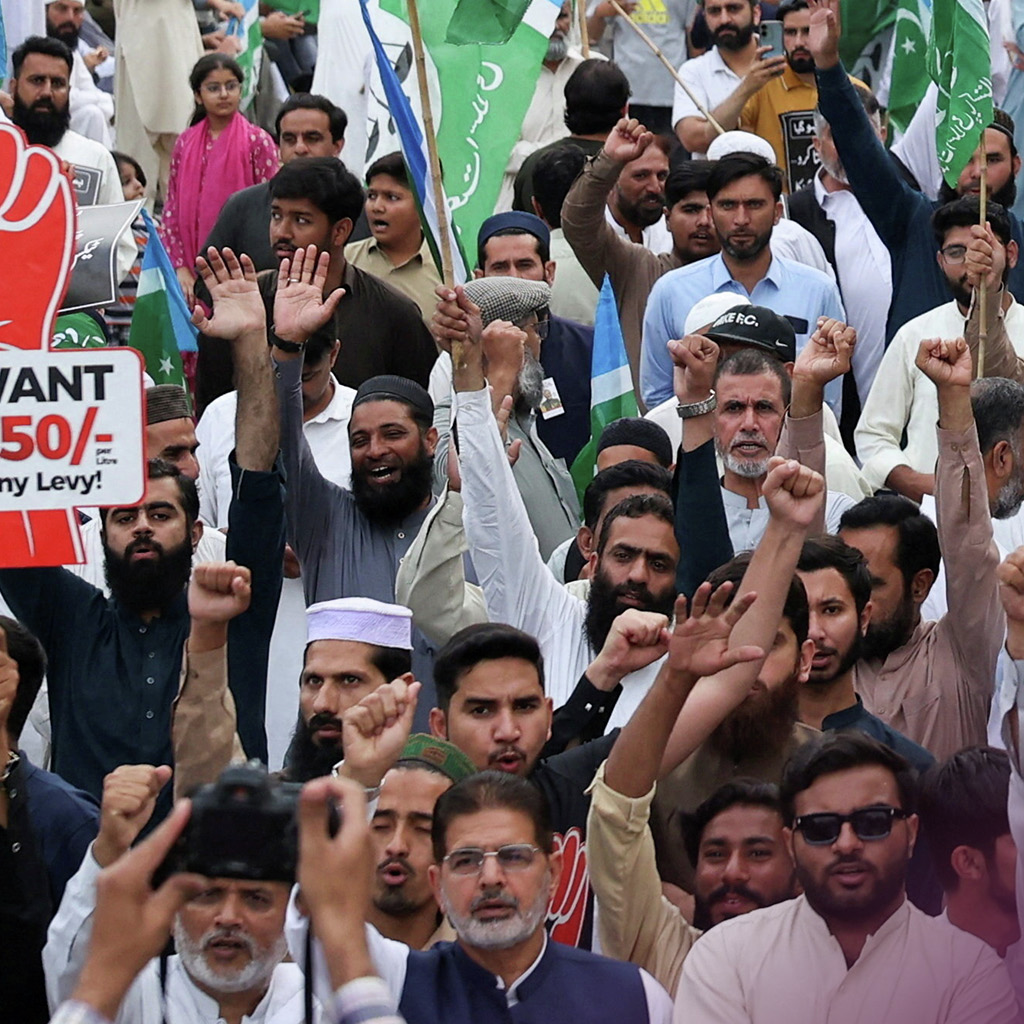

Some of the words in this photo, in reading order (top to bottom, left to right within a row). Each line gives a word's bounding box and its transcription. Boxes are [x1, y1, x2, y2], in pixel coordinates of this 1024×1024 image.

[0, 406, 113, 466] 50/-
[0, 477, 29, 497] ny
[37, 470, 102, 495] Levy!
